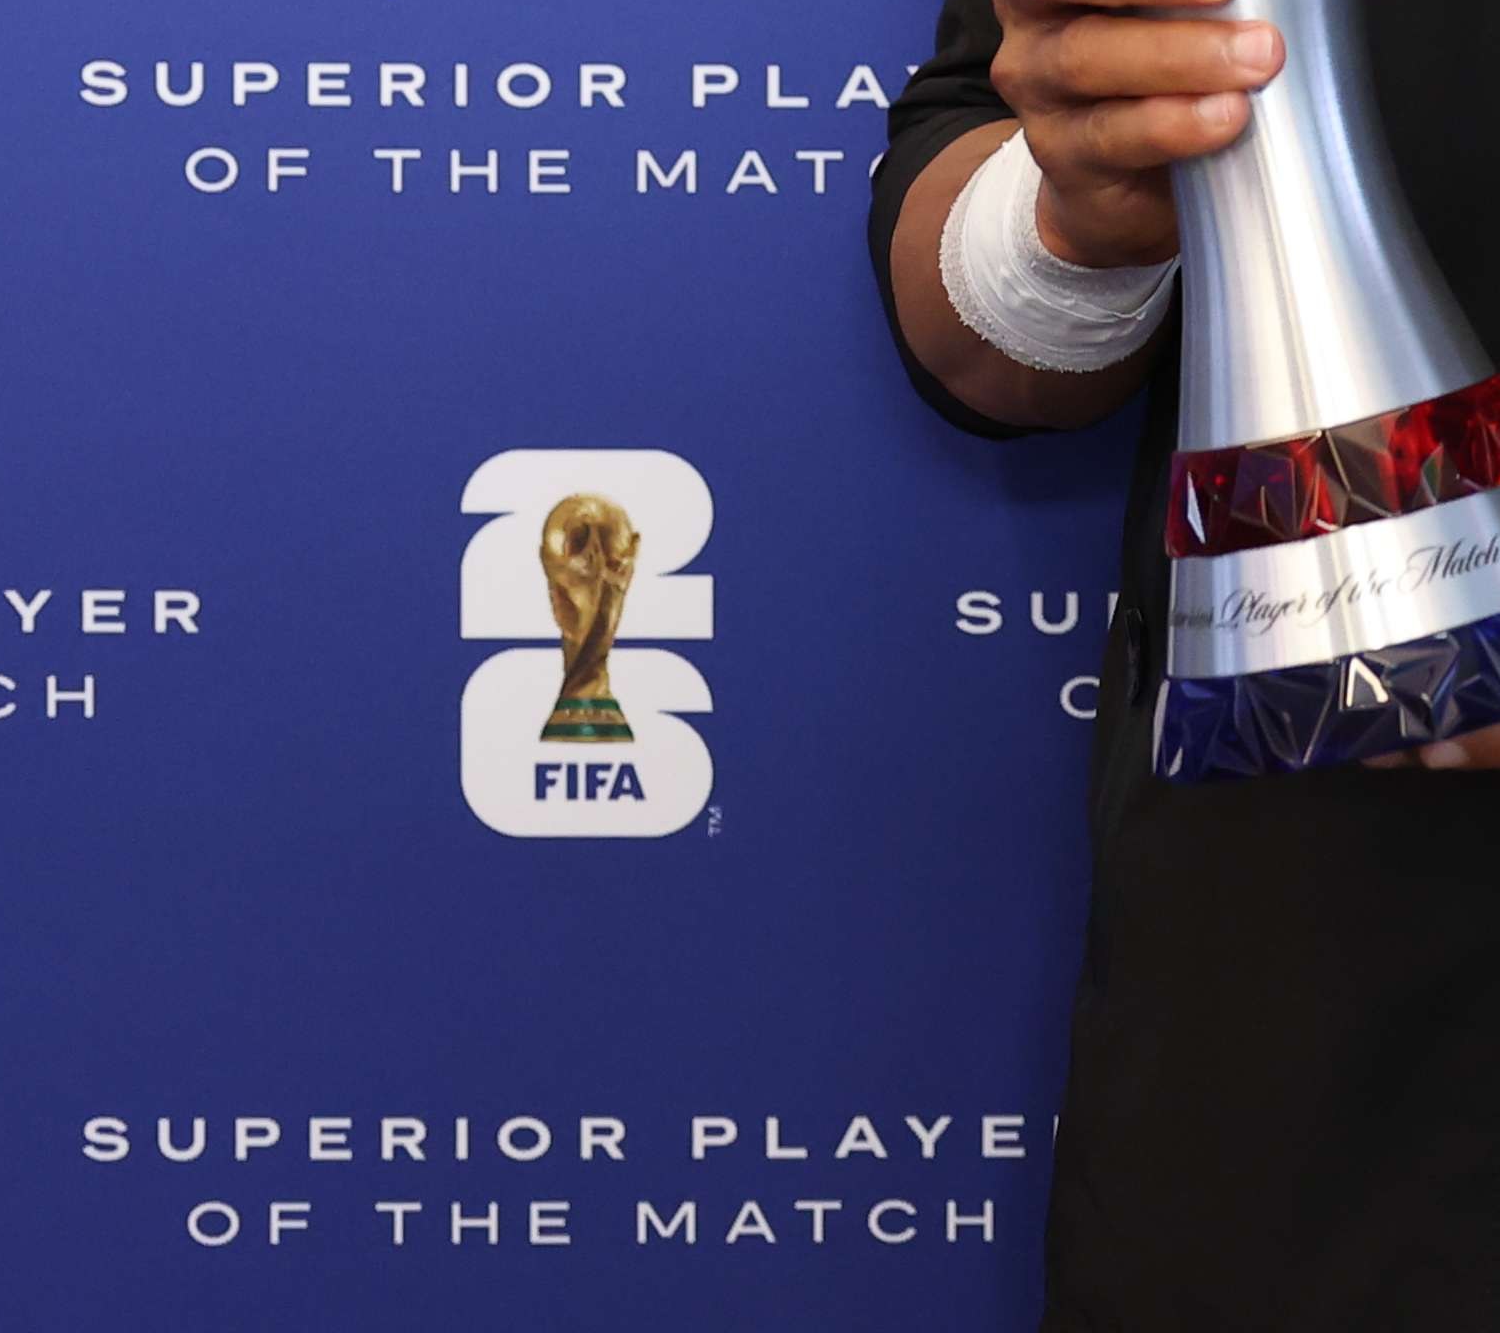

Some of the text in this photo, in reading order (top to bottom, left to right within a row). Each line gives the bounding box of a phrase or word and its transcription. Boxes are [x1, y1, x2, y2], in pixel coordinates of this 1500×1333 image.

[79, 60, 918, 109] SUPERIOR PLA
[184, 147, 886, 194] OF THE MAT
[1214, 587, 1307, 637] Player
[1314, 577, 1348, 625] of
[1392, 535, 1500, 591] Match
[1060, 675, 1100, 719] O
[534, 762, 644, 799] FIFA
[82, 1116, 1059, 1162] SUPERIOR PLAYE
[187, 1199, 994, 1246] OF THE MATCH
